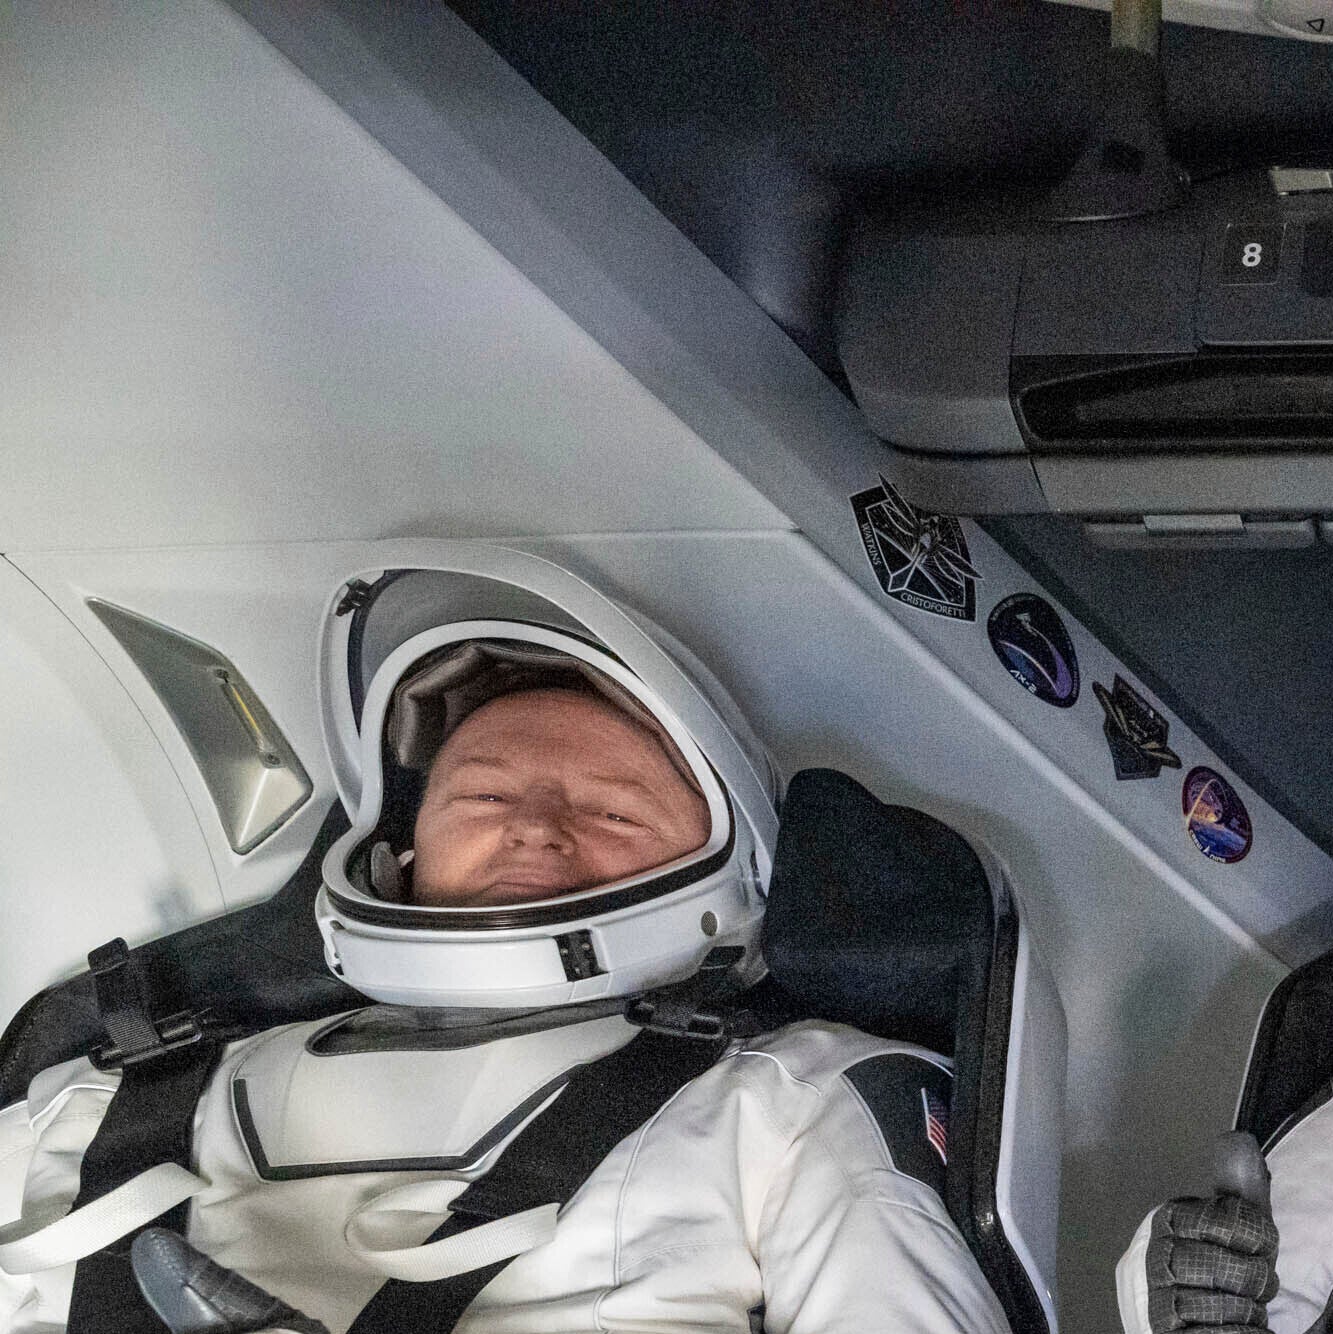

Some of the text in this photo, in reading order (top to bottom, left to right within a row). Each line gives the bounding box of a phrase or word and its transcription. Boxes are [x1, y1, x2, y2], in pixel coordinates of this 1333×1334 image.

[1242, 242, 1262, 267] 8
[861, 522, 882, 566] WATKINS
[900, 591, 966, 618] CRISTOFORETTI
